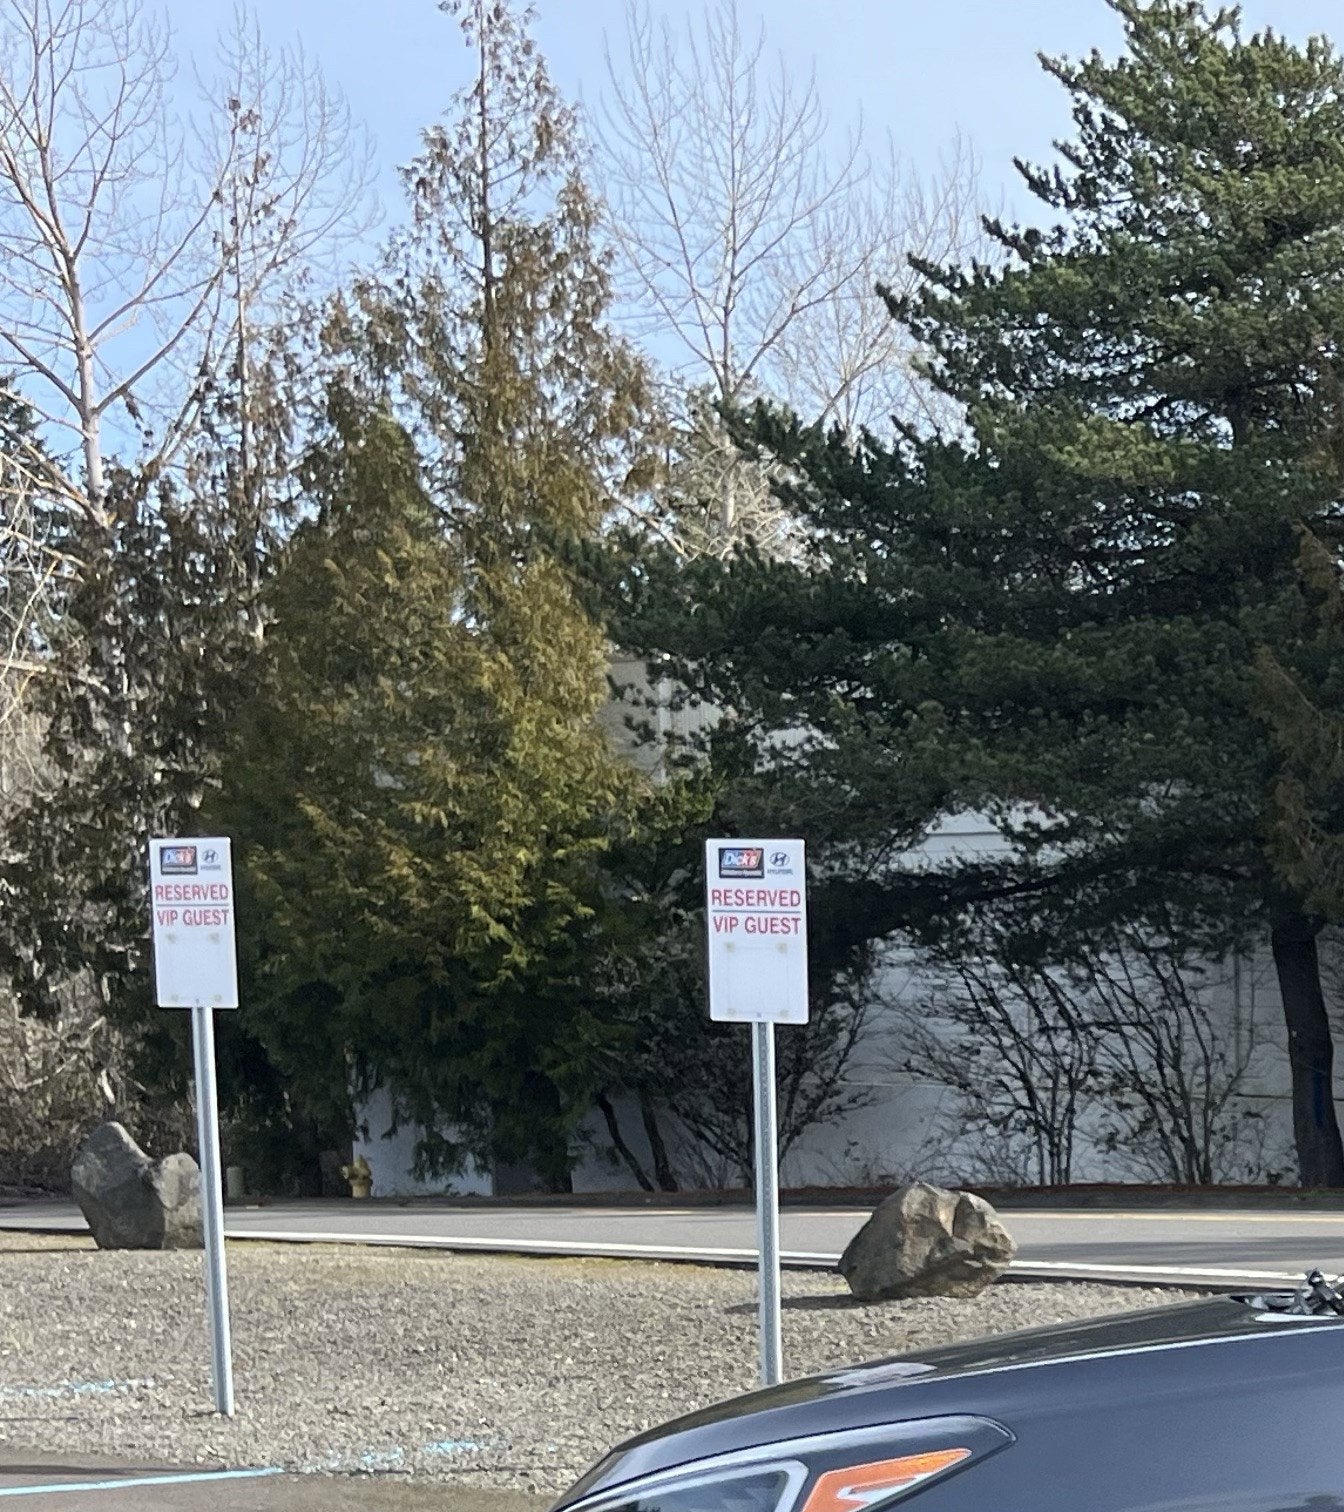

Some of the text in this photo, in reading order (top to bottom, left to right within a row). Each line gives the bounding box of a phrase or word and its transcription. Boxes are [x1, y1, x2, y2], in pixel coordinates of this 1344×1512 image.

[155, 884, 229, 901] RESERVED
[712, 889, 801, 907] RESERVED
[157, 909, 229, 926] VIP GUEST
[713, 916, 802, 934] VIP GUEST
